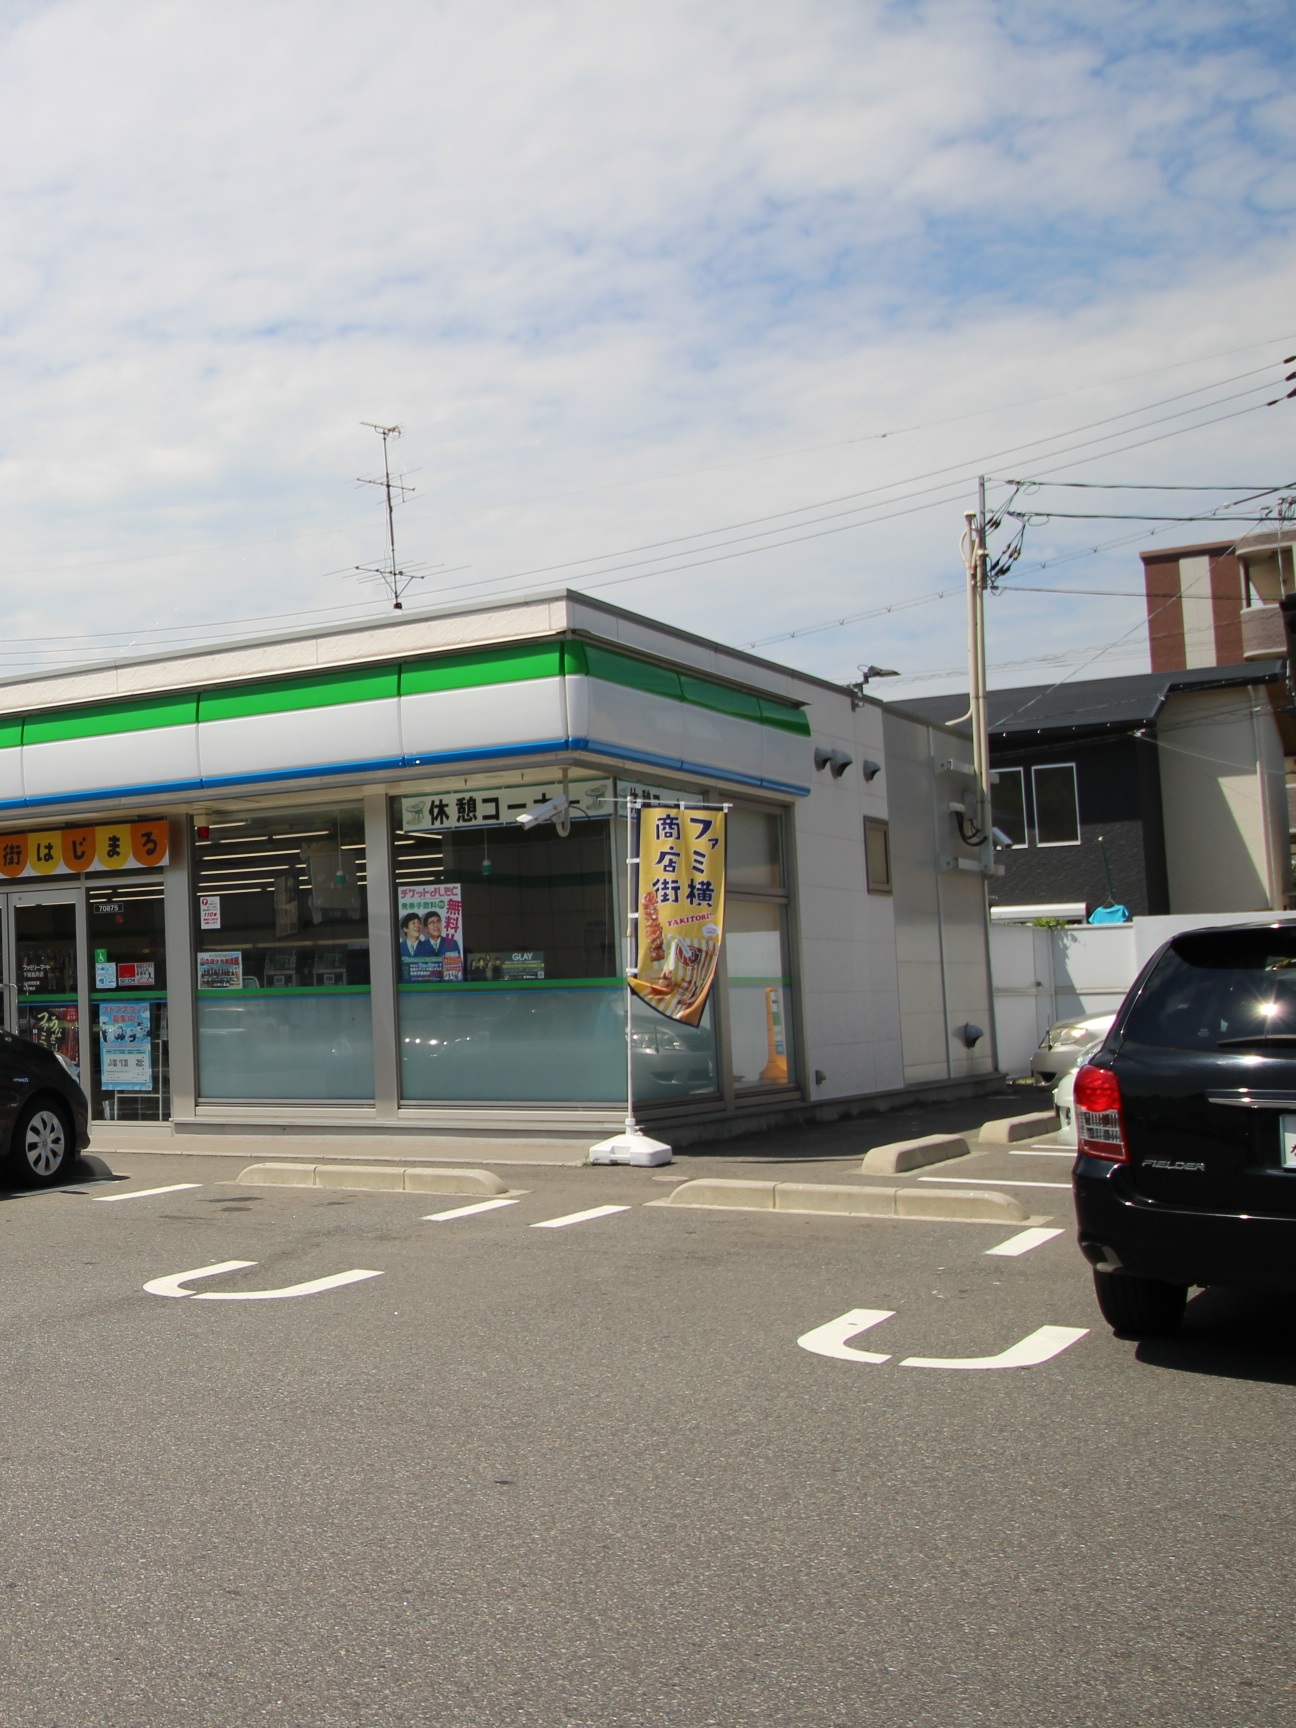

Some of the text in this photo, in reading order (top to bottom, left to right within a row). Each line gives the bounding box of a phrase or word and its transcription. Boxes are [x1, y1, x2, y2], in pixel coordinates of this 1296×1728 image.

[652, 814, 681, 904] 商店街
[685, 817, 719, 908] ファミ横
[99, 904, 119, 912] 70875
[512, 952, 533, 961] GLAY
[1142, 1159, 1205, 1171] FIELDER
